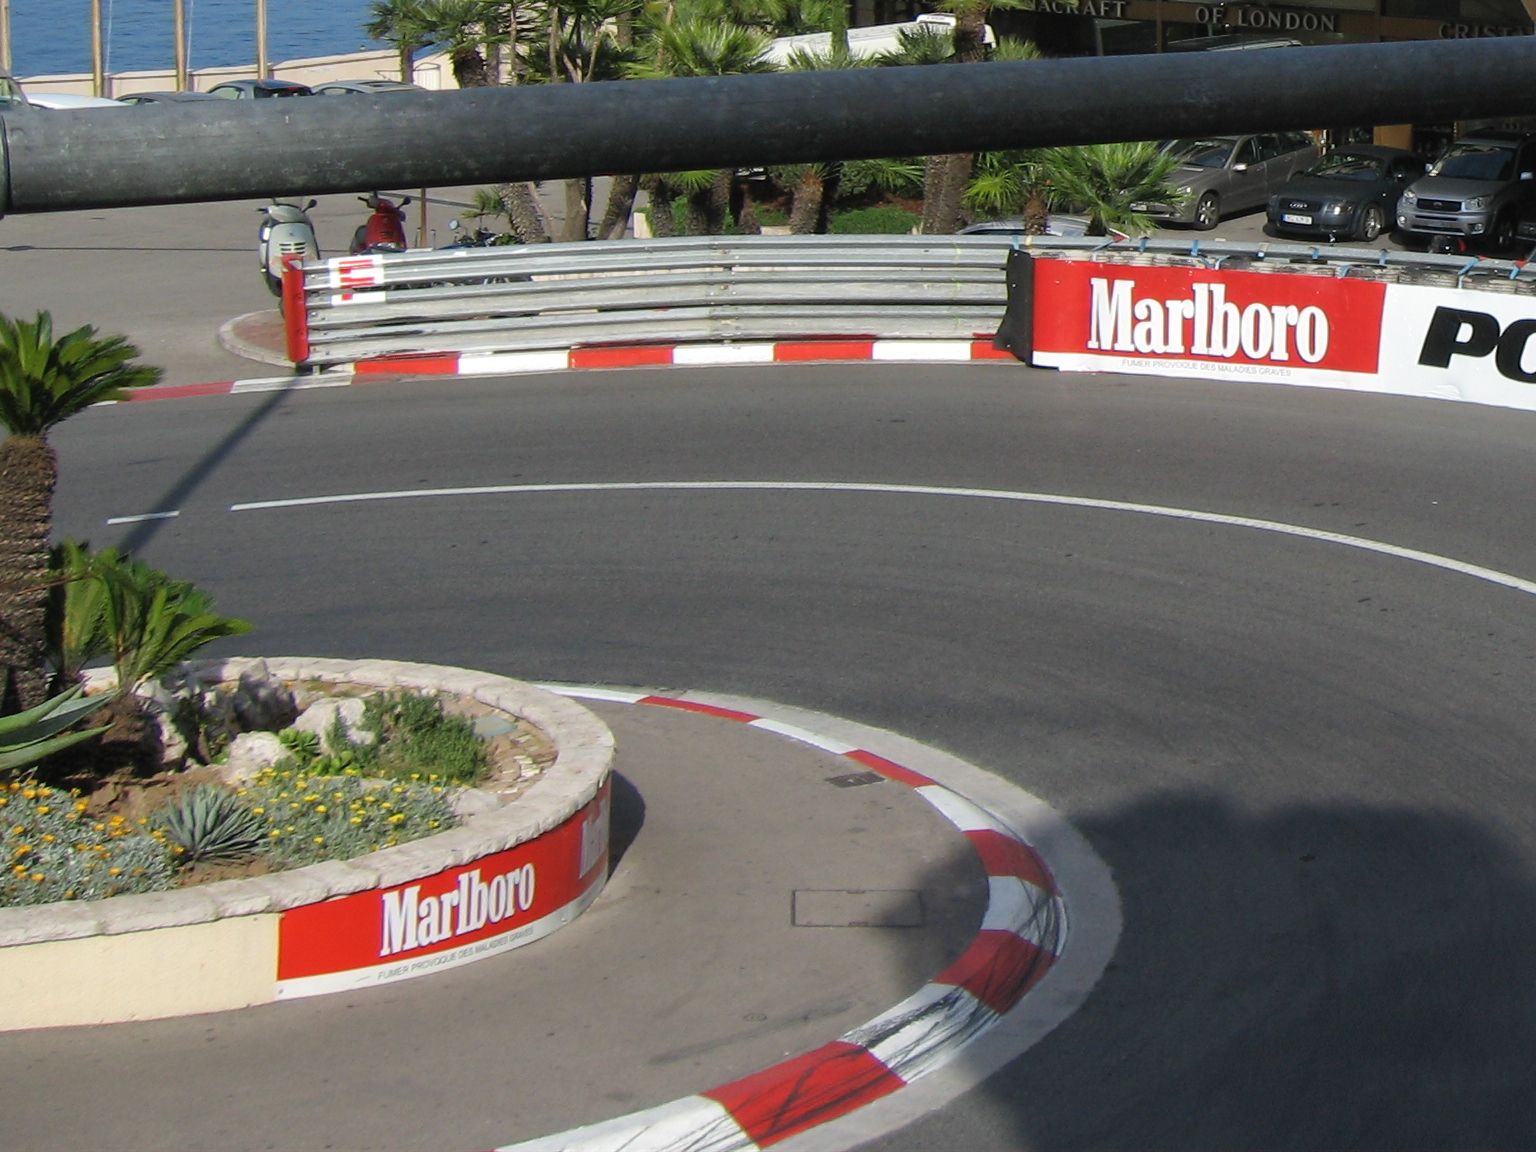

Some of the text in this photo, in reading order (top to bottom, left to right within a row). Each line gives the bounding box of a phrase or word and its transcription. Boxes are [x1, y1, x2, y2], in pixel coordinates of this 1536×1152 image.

[1195, 6, 1224, 25] OF
[1237, 9, 1335, 32] LONDON
[1087, 277, 1329, 364] Marlboro
[1121, 359, 1292, 377] FUMER PROVOQUE DES MALADIES GRAVES
[379, 862, 537, 957] Marlboro
[377, 965, 409, 981] FUMER
